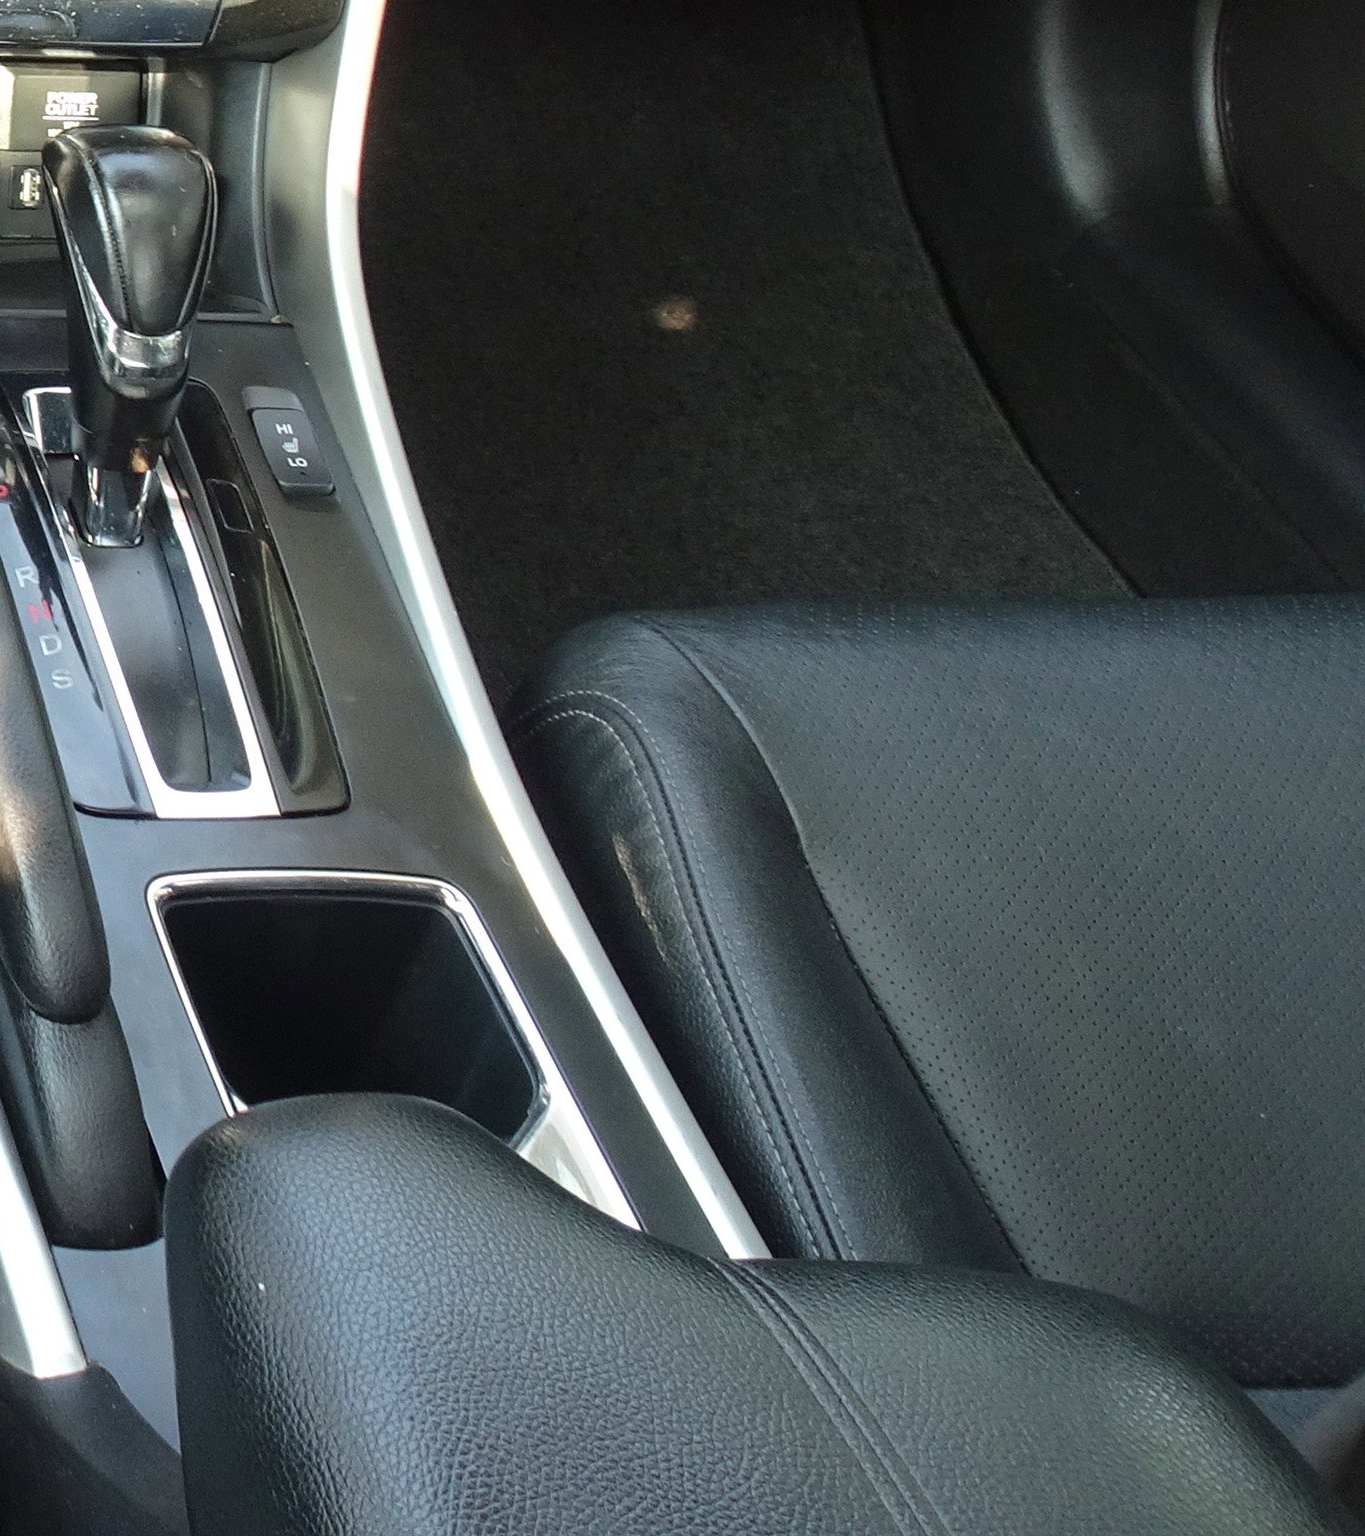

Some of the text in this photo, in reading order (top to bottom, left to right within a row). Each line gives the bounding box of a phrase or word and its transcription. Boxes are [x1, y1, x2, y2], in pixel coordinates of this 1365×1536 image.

[44, 103, 100, 116] OUTLET
[275, 423, 295, 435] HI
[286, 457, 309, 468] LO
[14, 565, 40, 589] R
[27, 599, 52, 625] N
[38, 634, 63, 657] D
[51, 668, 73, 690] S
